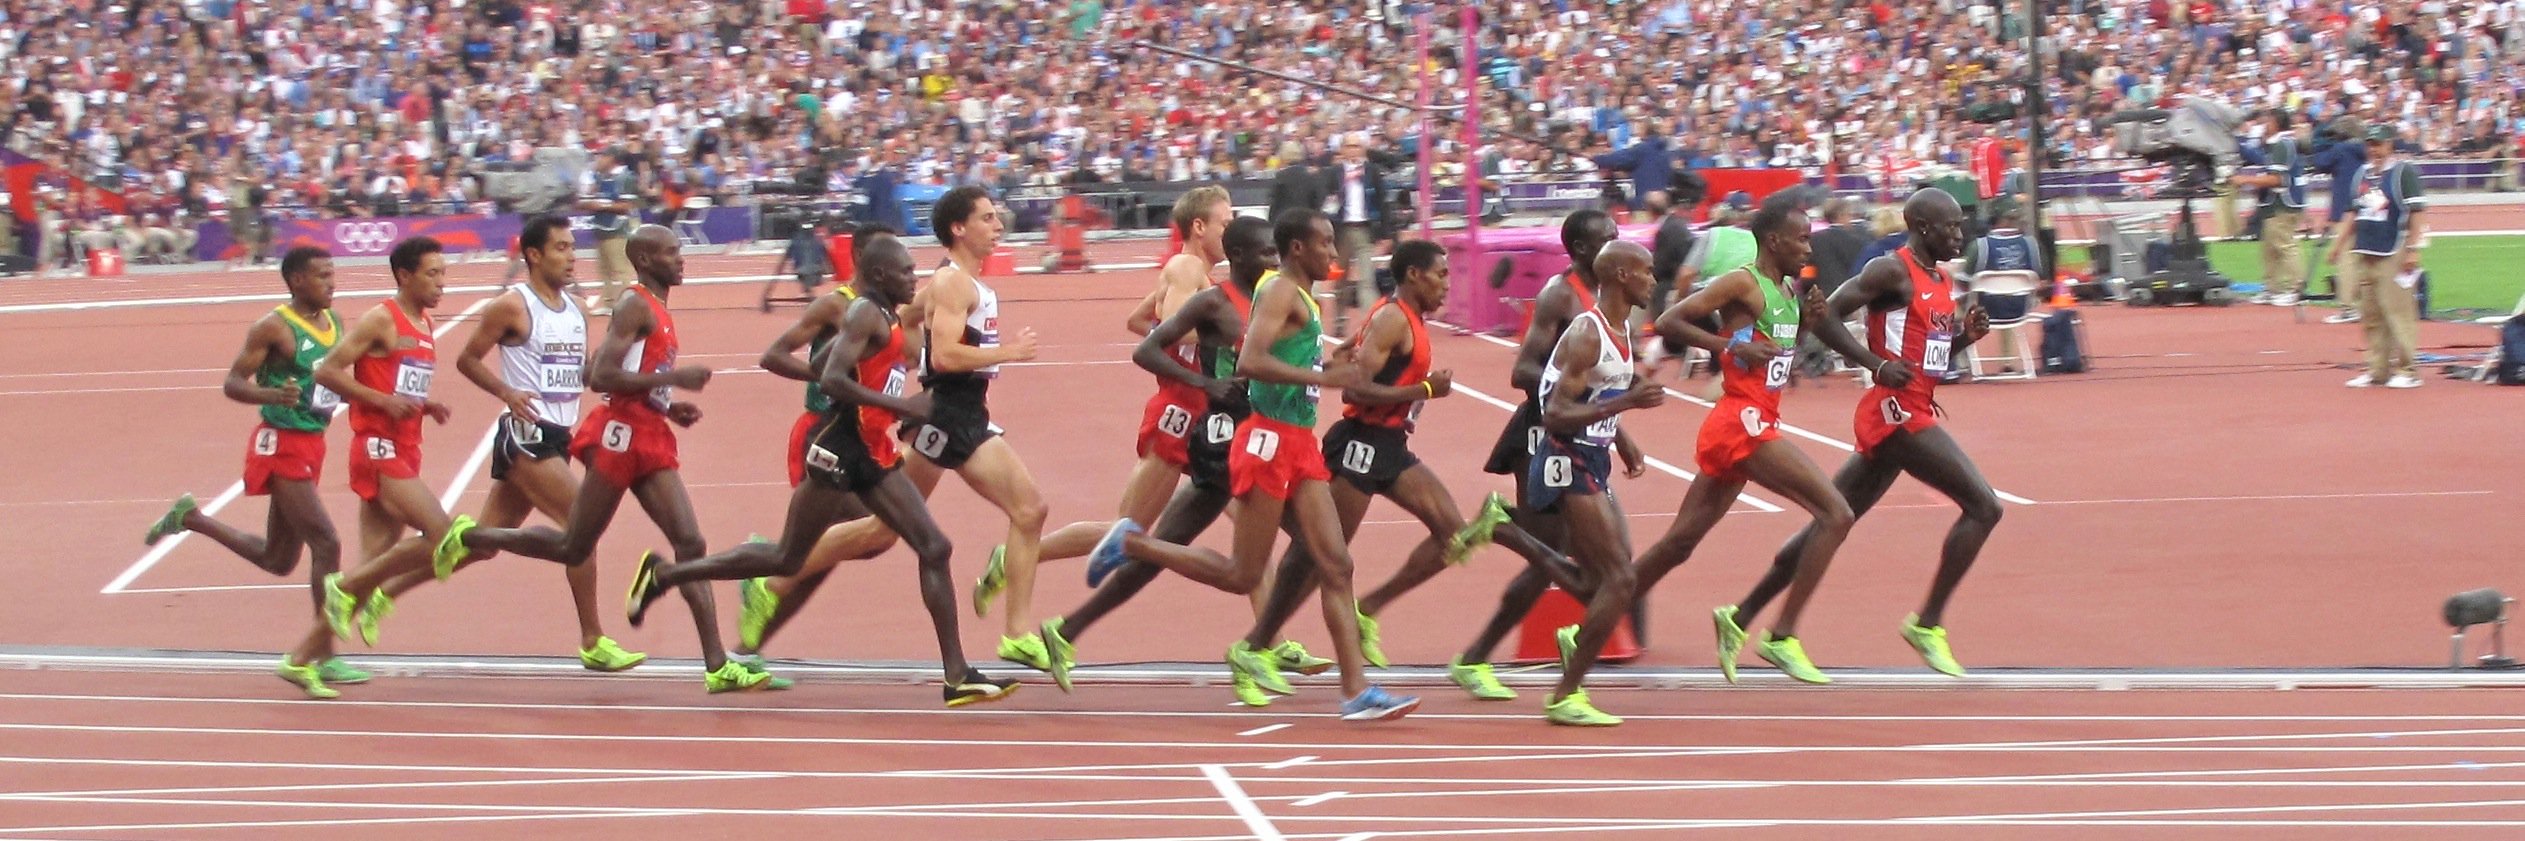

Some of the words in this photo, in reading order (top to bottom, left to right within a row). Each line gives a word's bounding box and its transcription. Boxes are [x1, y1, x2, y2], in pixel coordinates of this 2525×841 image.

[1164, 407, 1188, 434] 13
[1888, 399, 1902, 421] 8
[607, 424, 624, 447] 5
[1214, 416, 1225, 440] 2
[258, 431, 271, 453] 4
[376, 437, 387, 458] 6
[924, 430, 939, 451] 9
[1258, 433, 1267, 455] 1
[1349, 442, 1369, 469] 11
[1552, 458, 1563, 483] 3
